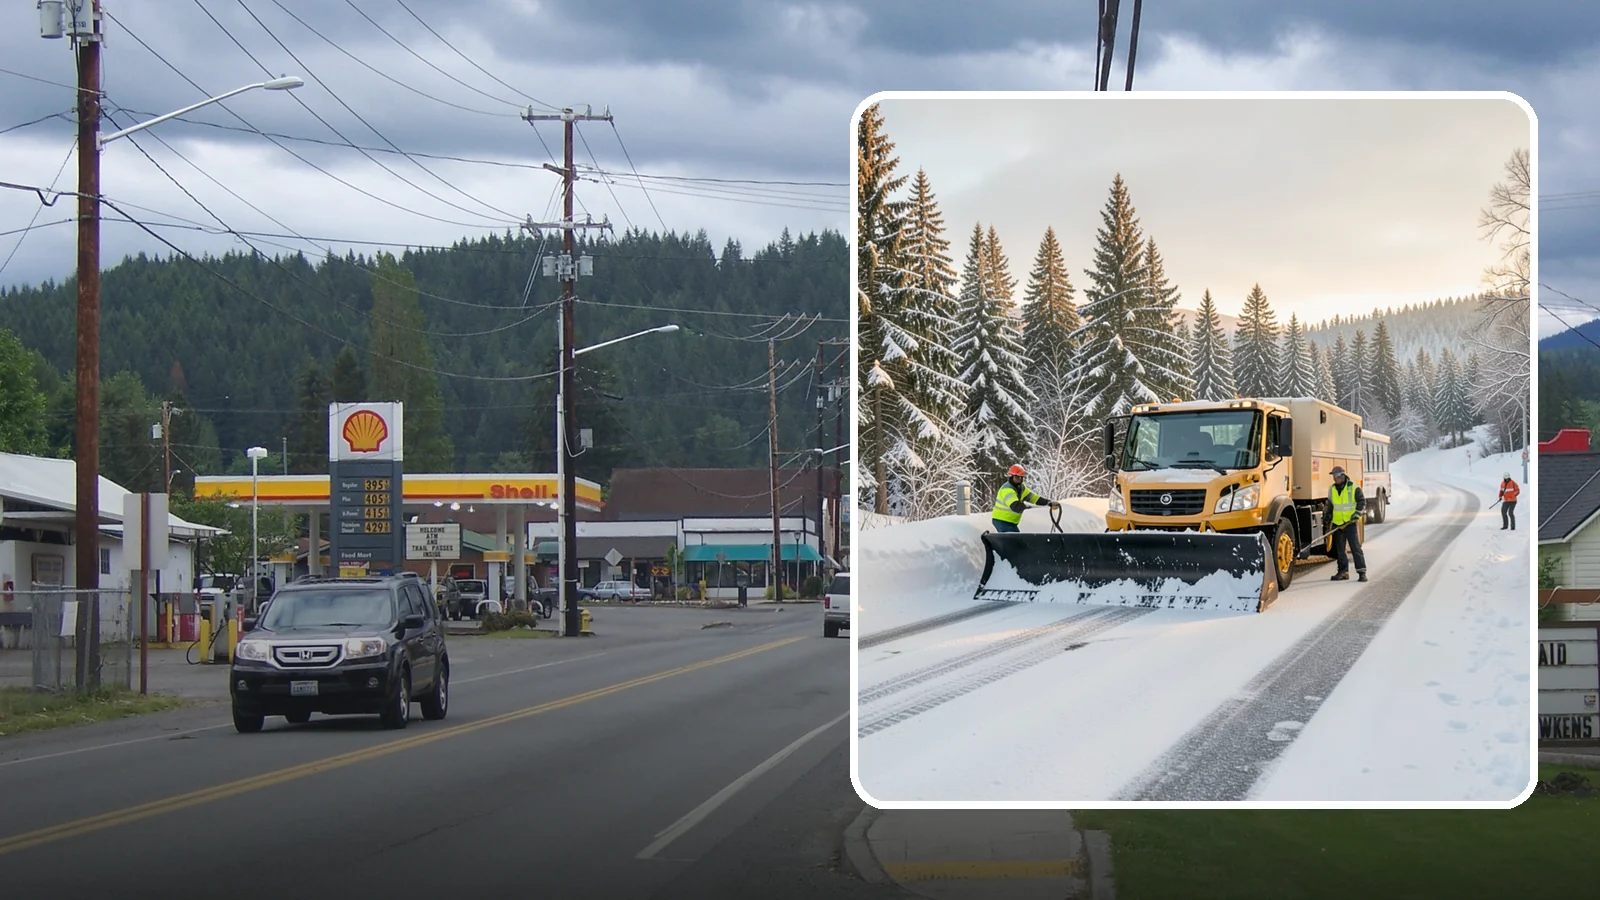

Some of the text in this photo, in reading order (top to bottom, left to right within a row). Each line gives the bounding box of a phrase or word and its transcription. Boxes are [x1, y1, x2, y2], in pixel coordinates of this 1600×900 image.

[366, 480, 383, 490] 395
[490, 484, 547, 499] Shell
[366, 494, 383, 504] 405
[366, 508, 383, 518] 415
[366, 522, 383, 532] 429
[1538, 642, 1567, 665] AID
[1538, 716, 1592, 739] WKENS
